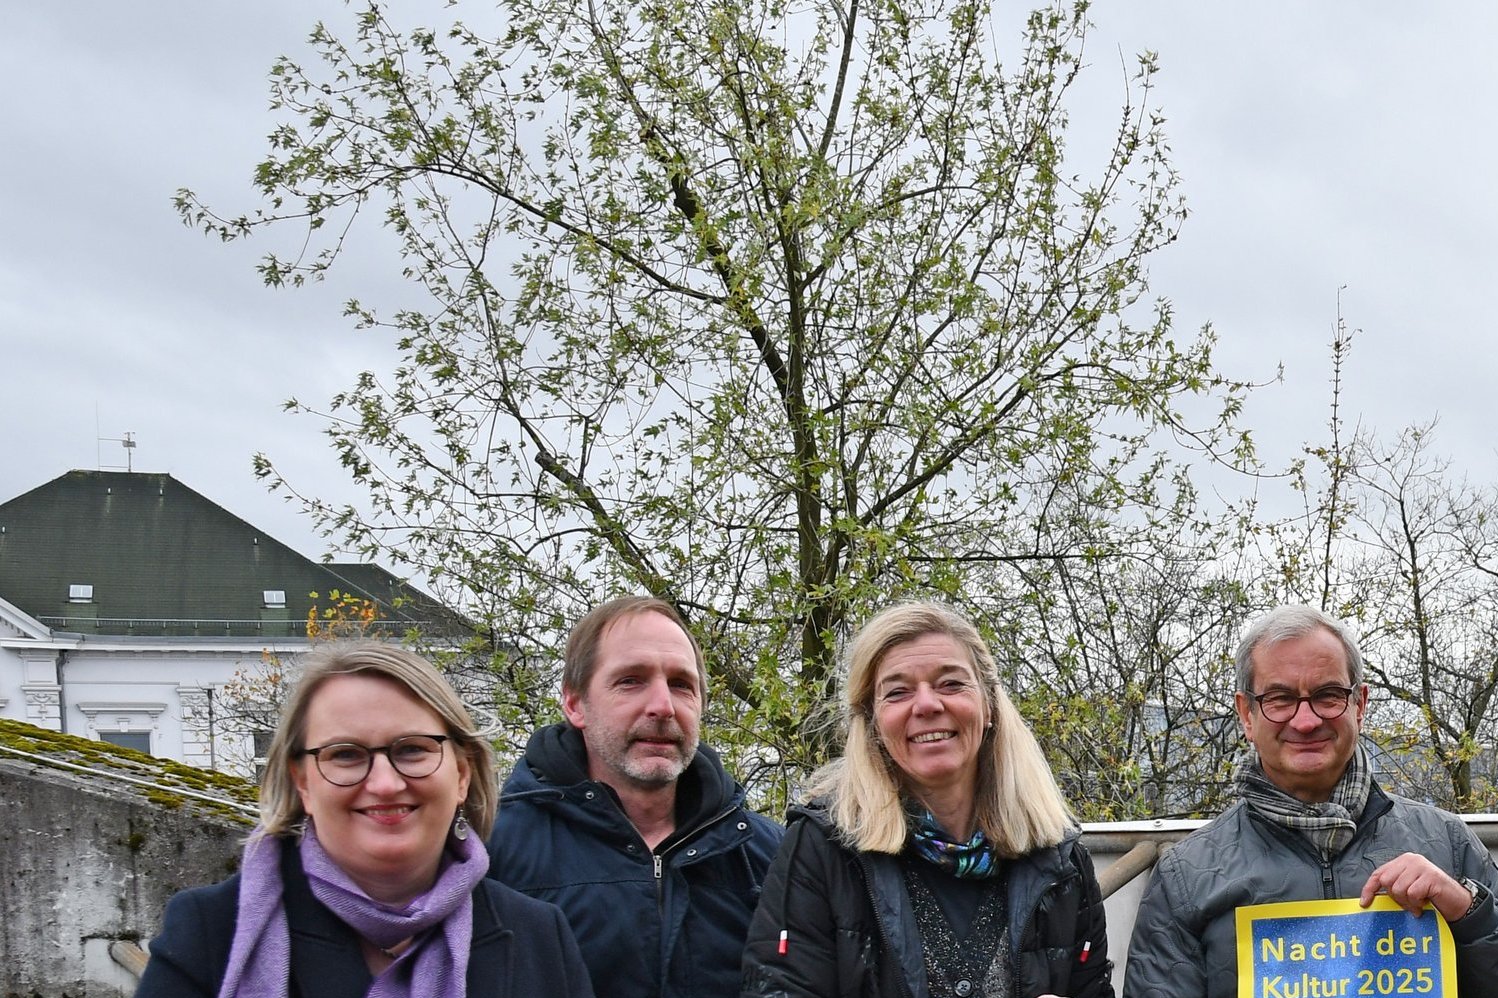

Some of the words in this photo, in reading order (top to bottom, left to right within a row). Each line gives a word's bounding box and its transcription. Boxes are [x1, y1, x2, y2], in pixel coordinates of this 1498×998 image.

[1261, 933, 1361, 963] Nacht
[1376, 929, 1433, 955] der
[1357, 968, 1434, 996] 2025
